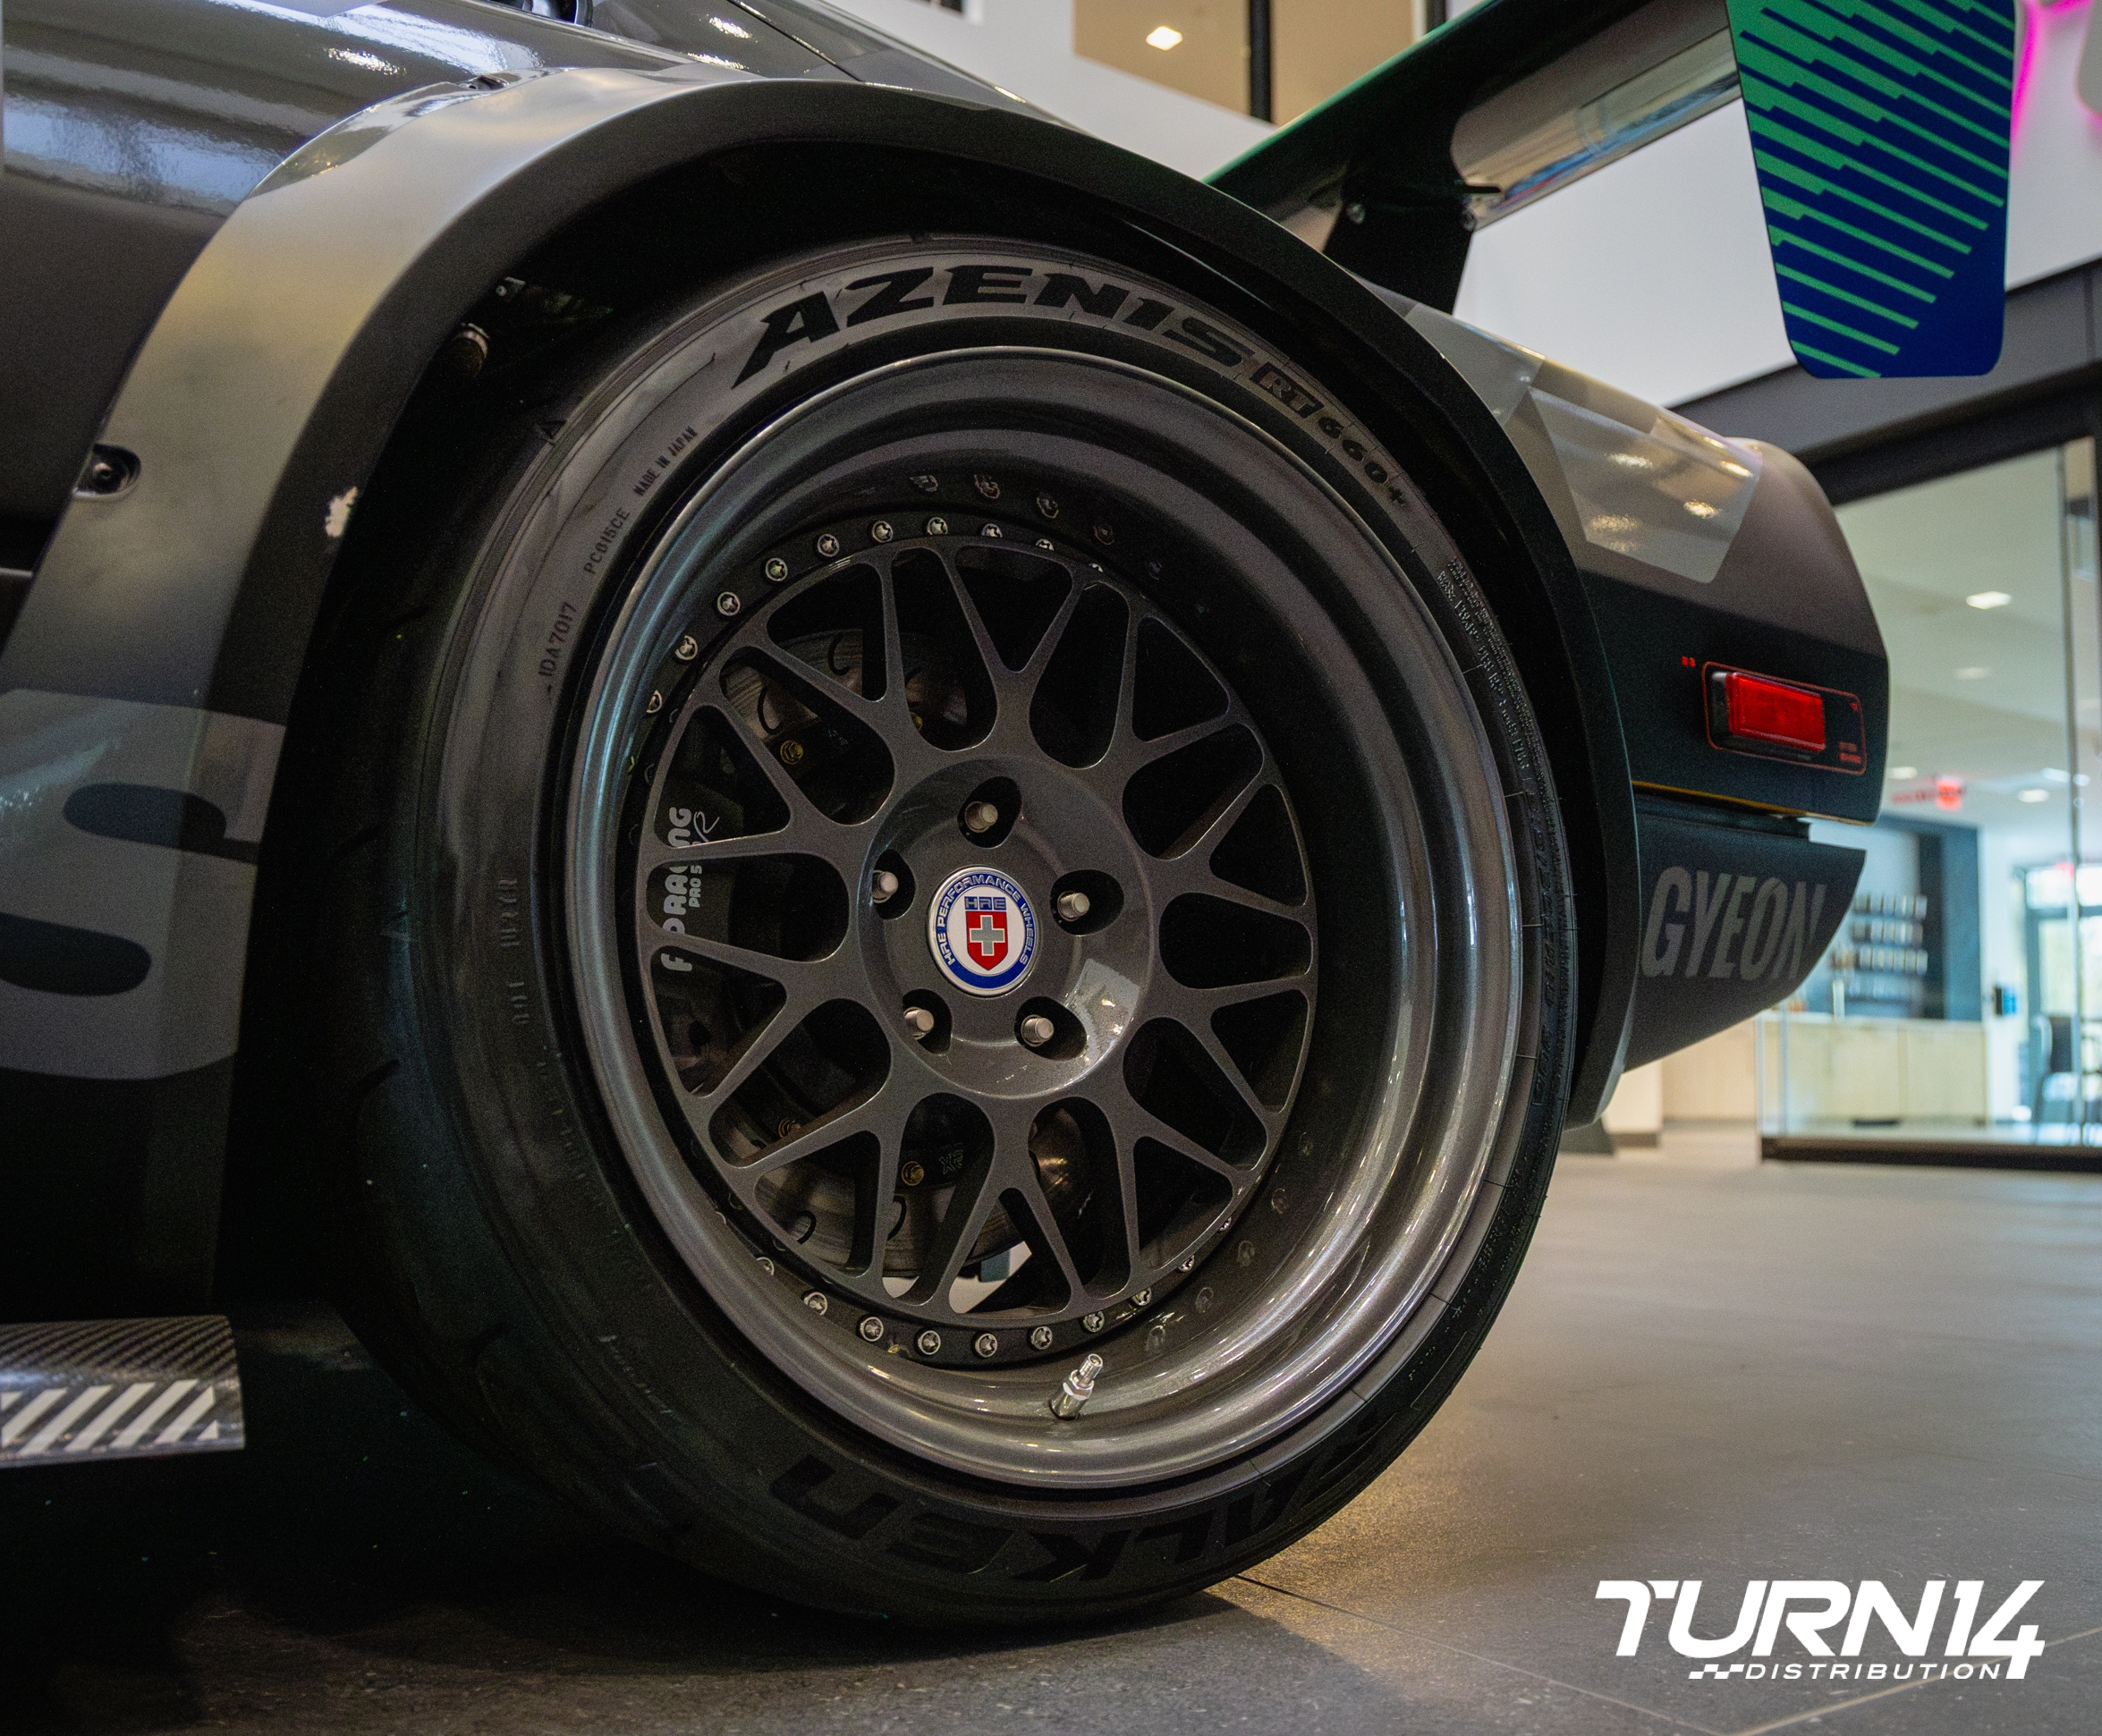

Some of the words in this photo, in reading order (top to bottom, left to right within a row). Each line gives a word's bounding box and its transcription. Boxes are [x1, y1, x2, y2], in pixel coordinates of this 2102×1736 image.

[732, 265, 1261, 389] AZENIS
[632, 470, 660, 496] MADE
[655, 454, 671, 470] IN
[671, 426, 699, 457] JAPAN
[663, 807, 692, 915] RANG
[689, 877, 701, 908] PRO
[937, 874, 1021, 927] PERFORMANCE
[965, 897, 1006, 910] HRE
[1020, 902, 1034, 965] WHEELS
[1641, 866, 1827, 980] GYEON
[937, 934, 956, 965] HRE
[767, 1407, 1382, 1581] FALKEN
